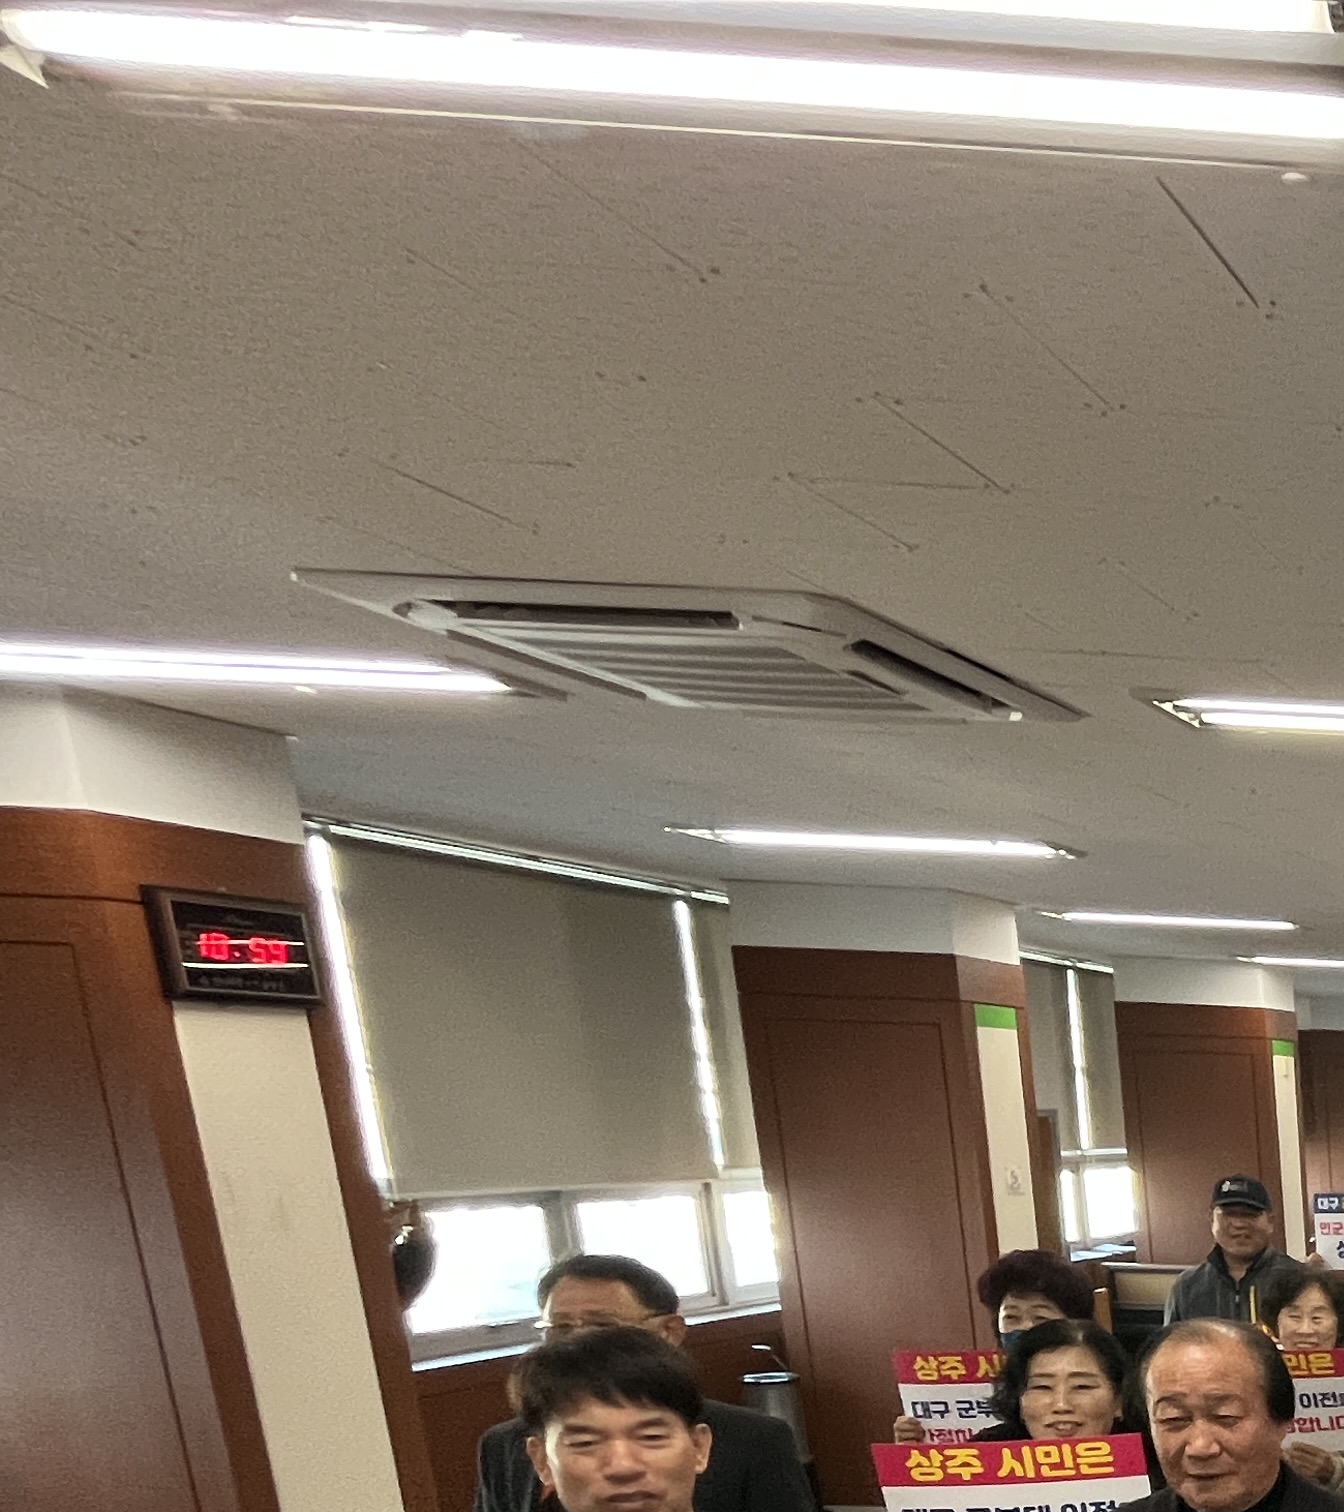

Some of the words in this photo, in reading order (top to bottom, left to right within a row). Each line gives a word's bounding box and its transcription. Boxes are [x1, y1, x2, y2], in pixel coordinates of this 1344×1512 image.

[1317, 1197, 1339, 1210] 대구
[913, 1355, 967, 1381] 상주
[911, 1400, 950, 1420] 대구
[906, 1449, 984, 1482] 상주
[997, 1441, 1115, 1480] 시민은
